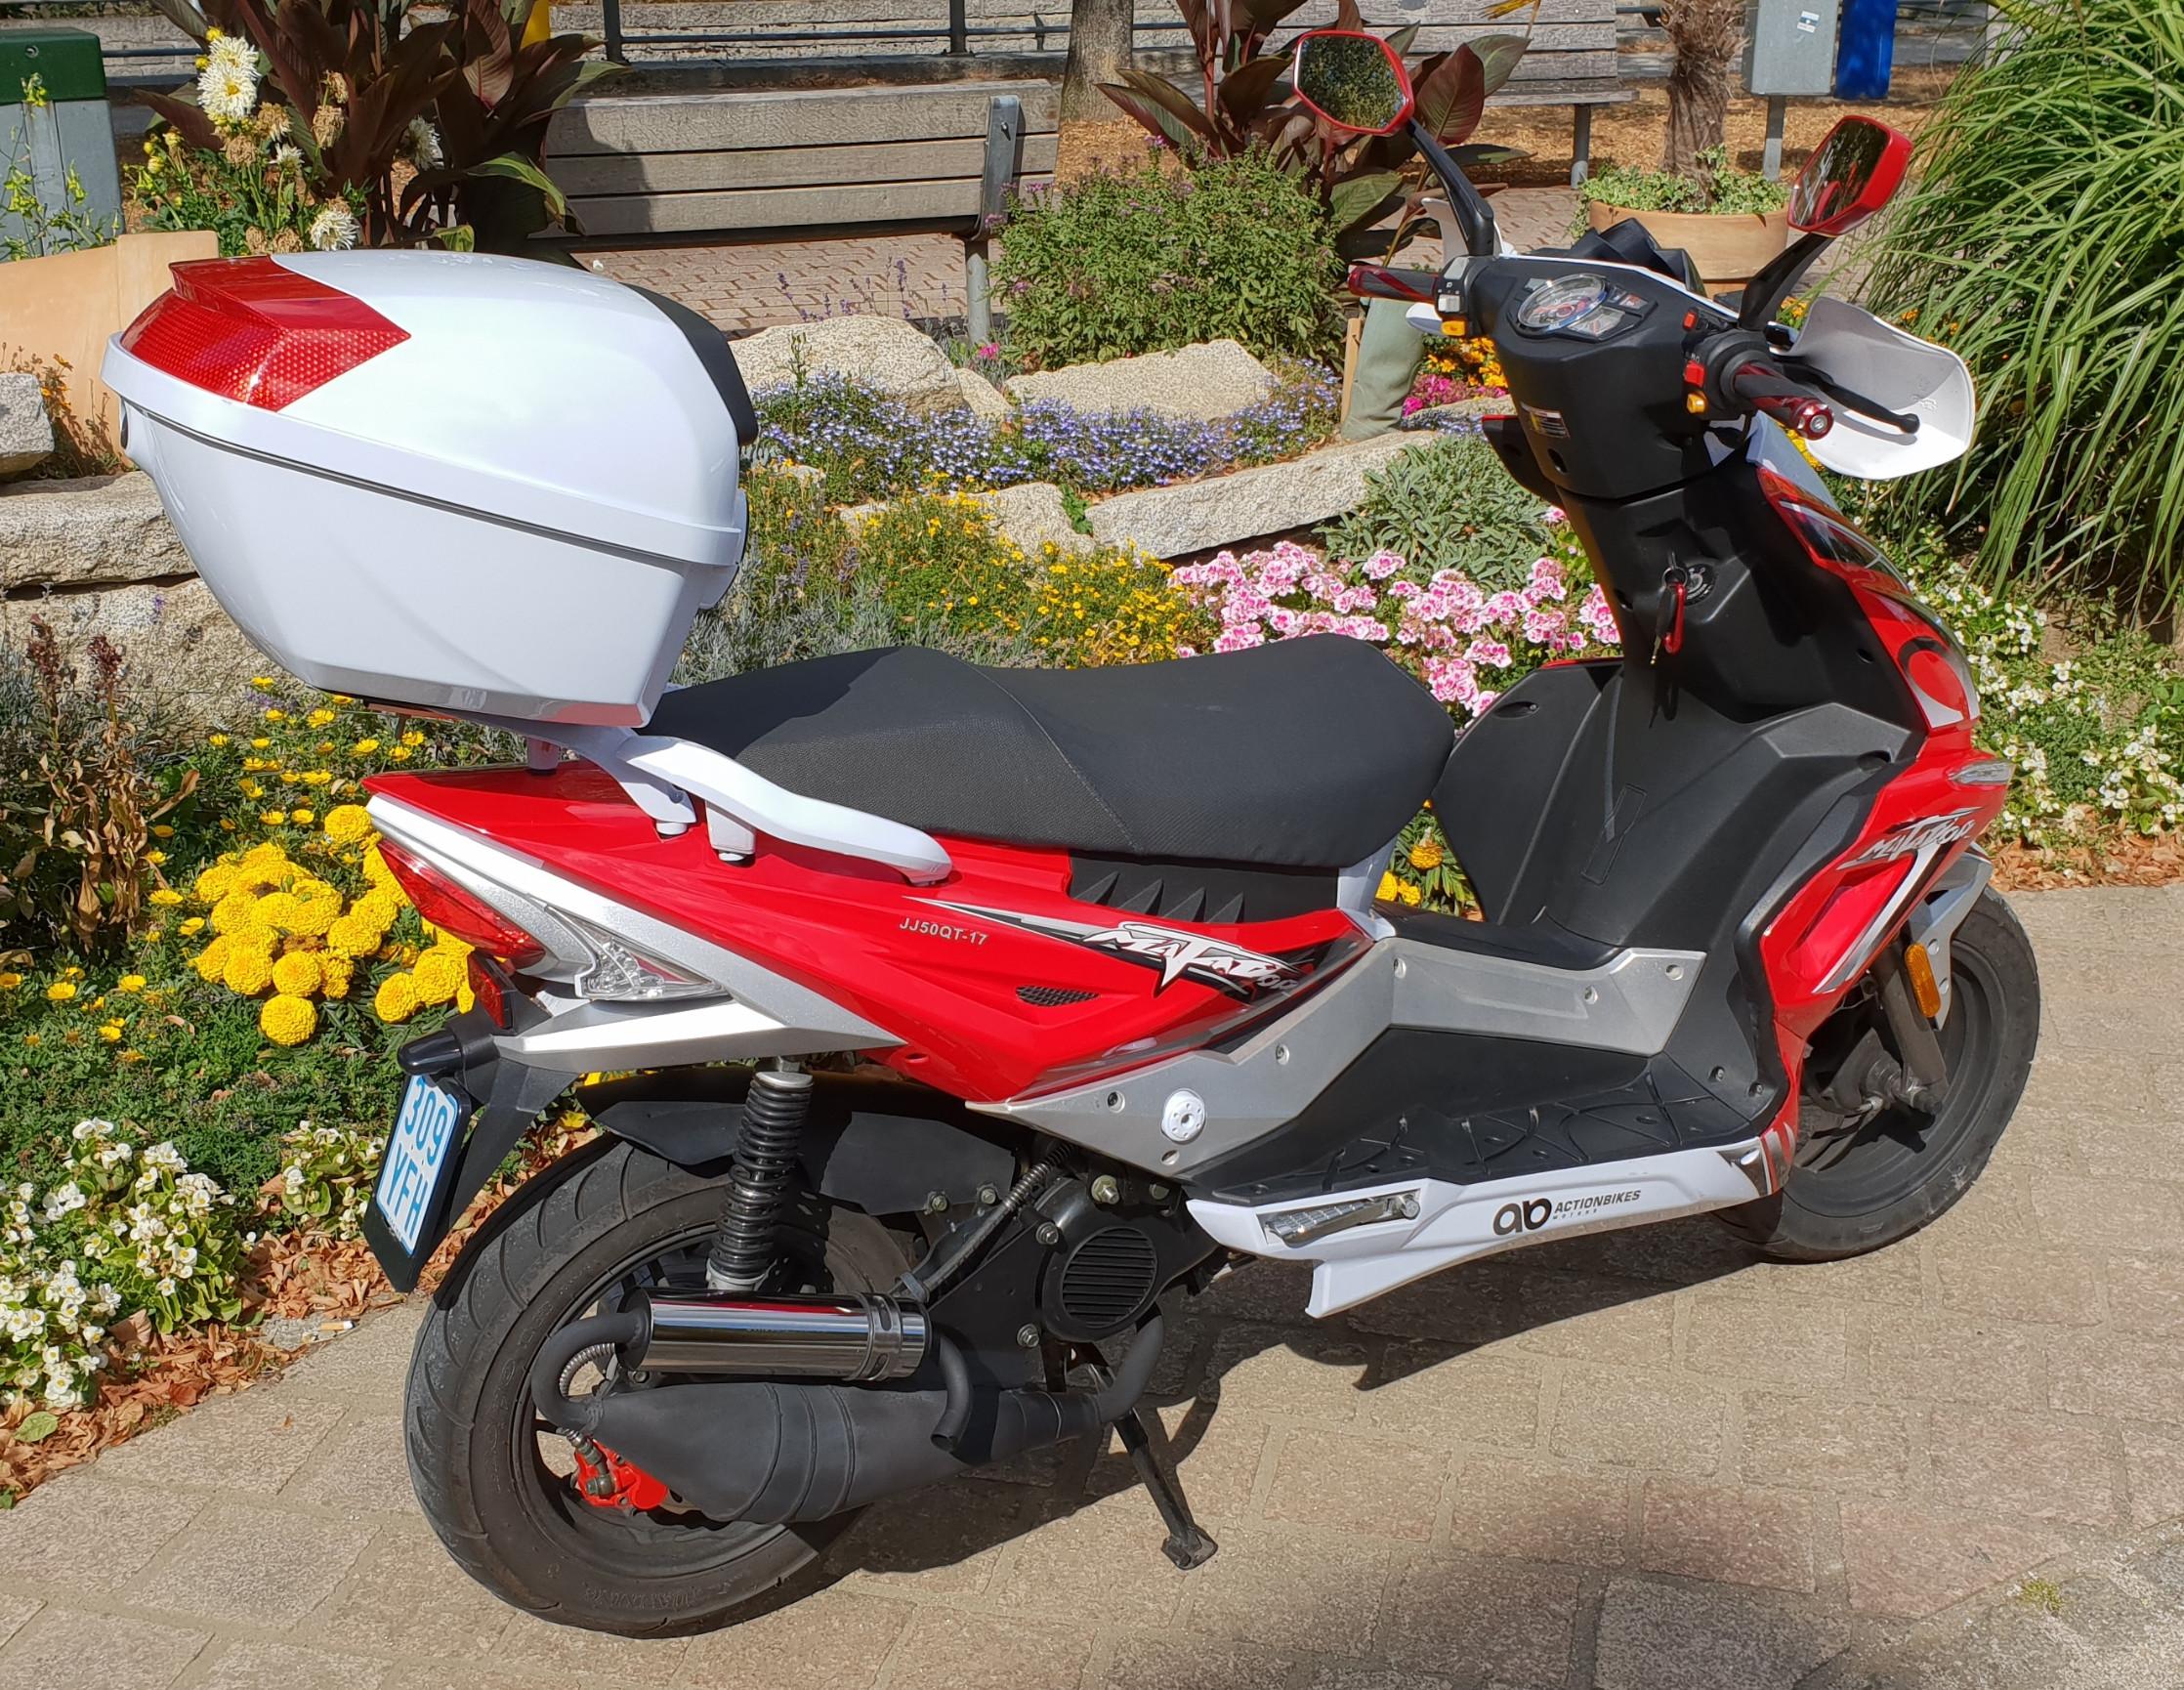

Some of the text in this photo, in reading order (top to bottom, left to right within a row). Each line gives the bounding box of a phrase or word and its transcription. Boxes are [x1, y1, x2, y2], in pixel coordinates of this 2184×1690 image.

[899, 917, 988, 946] JJ50QT-17
[1081, 922, 1301, 996] MATADOR
[404, 1077, 448, 1167] 309
[386, 1142, 429, 1241] YFH
[1554, 1190, 1642, 1214] ACTIONBIKES
